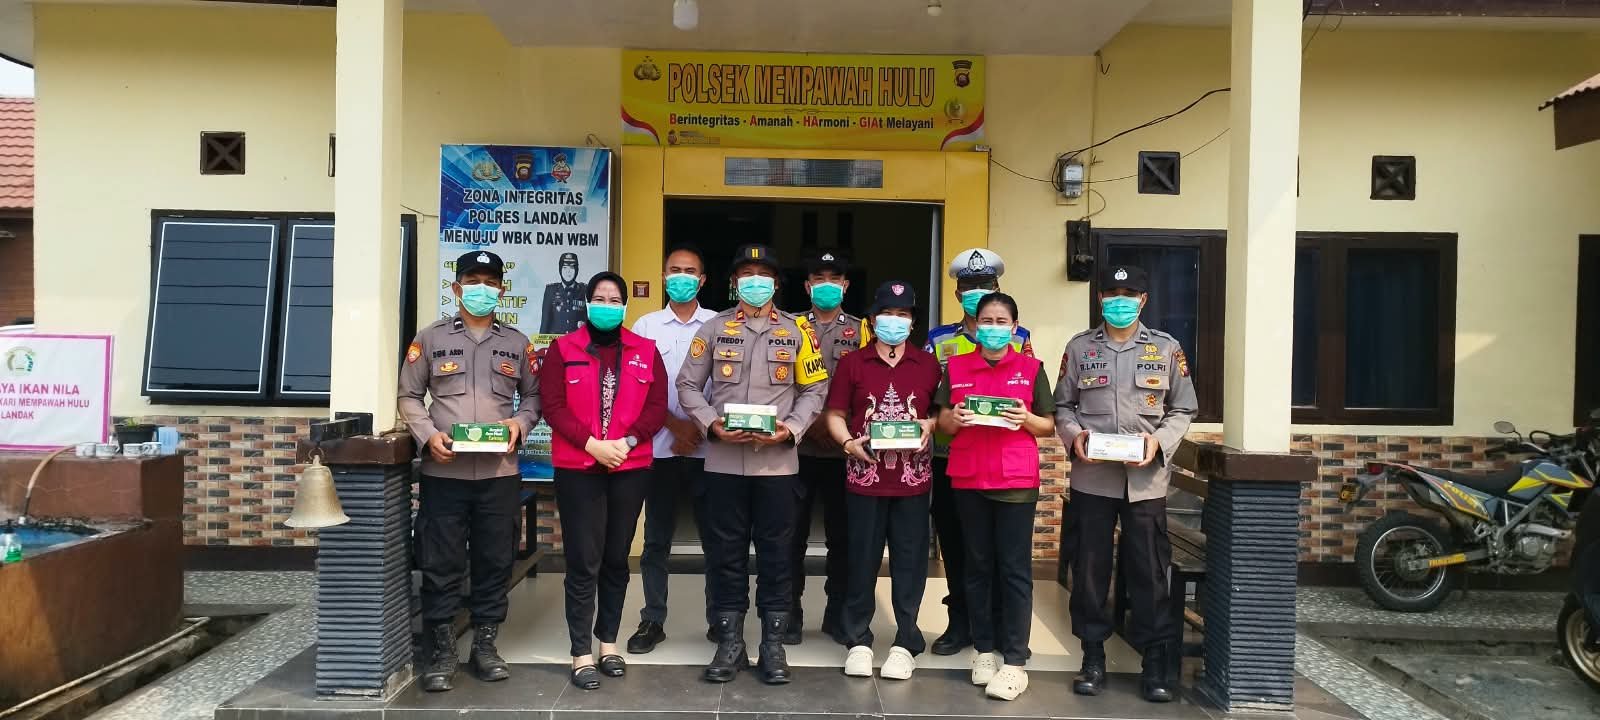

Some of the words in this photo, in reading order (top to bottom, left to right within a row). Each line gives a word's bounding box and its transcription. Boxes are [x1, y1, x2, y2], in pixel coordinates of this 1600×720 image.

[668, 63, 750, 104] POLSEK
[754, 64, 873, 106] MEMPAWAH
[878, 67, 935, 107] HULU
[669, 113, 740, 128] Berintegritas
[750, 115, 793, 127] Amanah
[803, 116, 850, 128] HArmoni
[859, 117, 883, 129] GIAt
[886, 117, 934, 131] Melayani
[463, 189, 499, 204] ZONA
[504, 190, 583, 205] INTEGRITAS
[469, 209, 520, 224] POLRES
[524, 211, 578, 226] LANDAK
[444, 229, 498, 243] MENUJU
[502, 231, 532, 245] WBK
[536, 232, 564, 246] DAN
[567, 232, 599, 247] WBM
[716, 336, 745, 345] FREDDY
[768, 338, 796, 347] POLRI
[492, 350, 519, 361] POLRI
[1137, 363, 1166, 372] POLRI
[0, 383, 15, 394] YA
[19, 384, 49, 395] IKAN
[53, 384, 80, 395] NILA
[18, 399, 65, 408] MEMPAWAH
[68, 399, 90, 408] HULU
[1, 411, 34, 420] LANDAK
